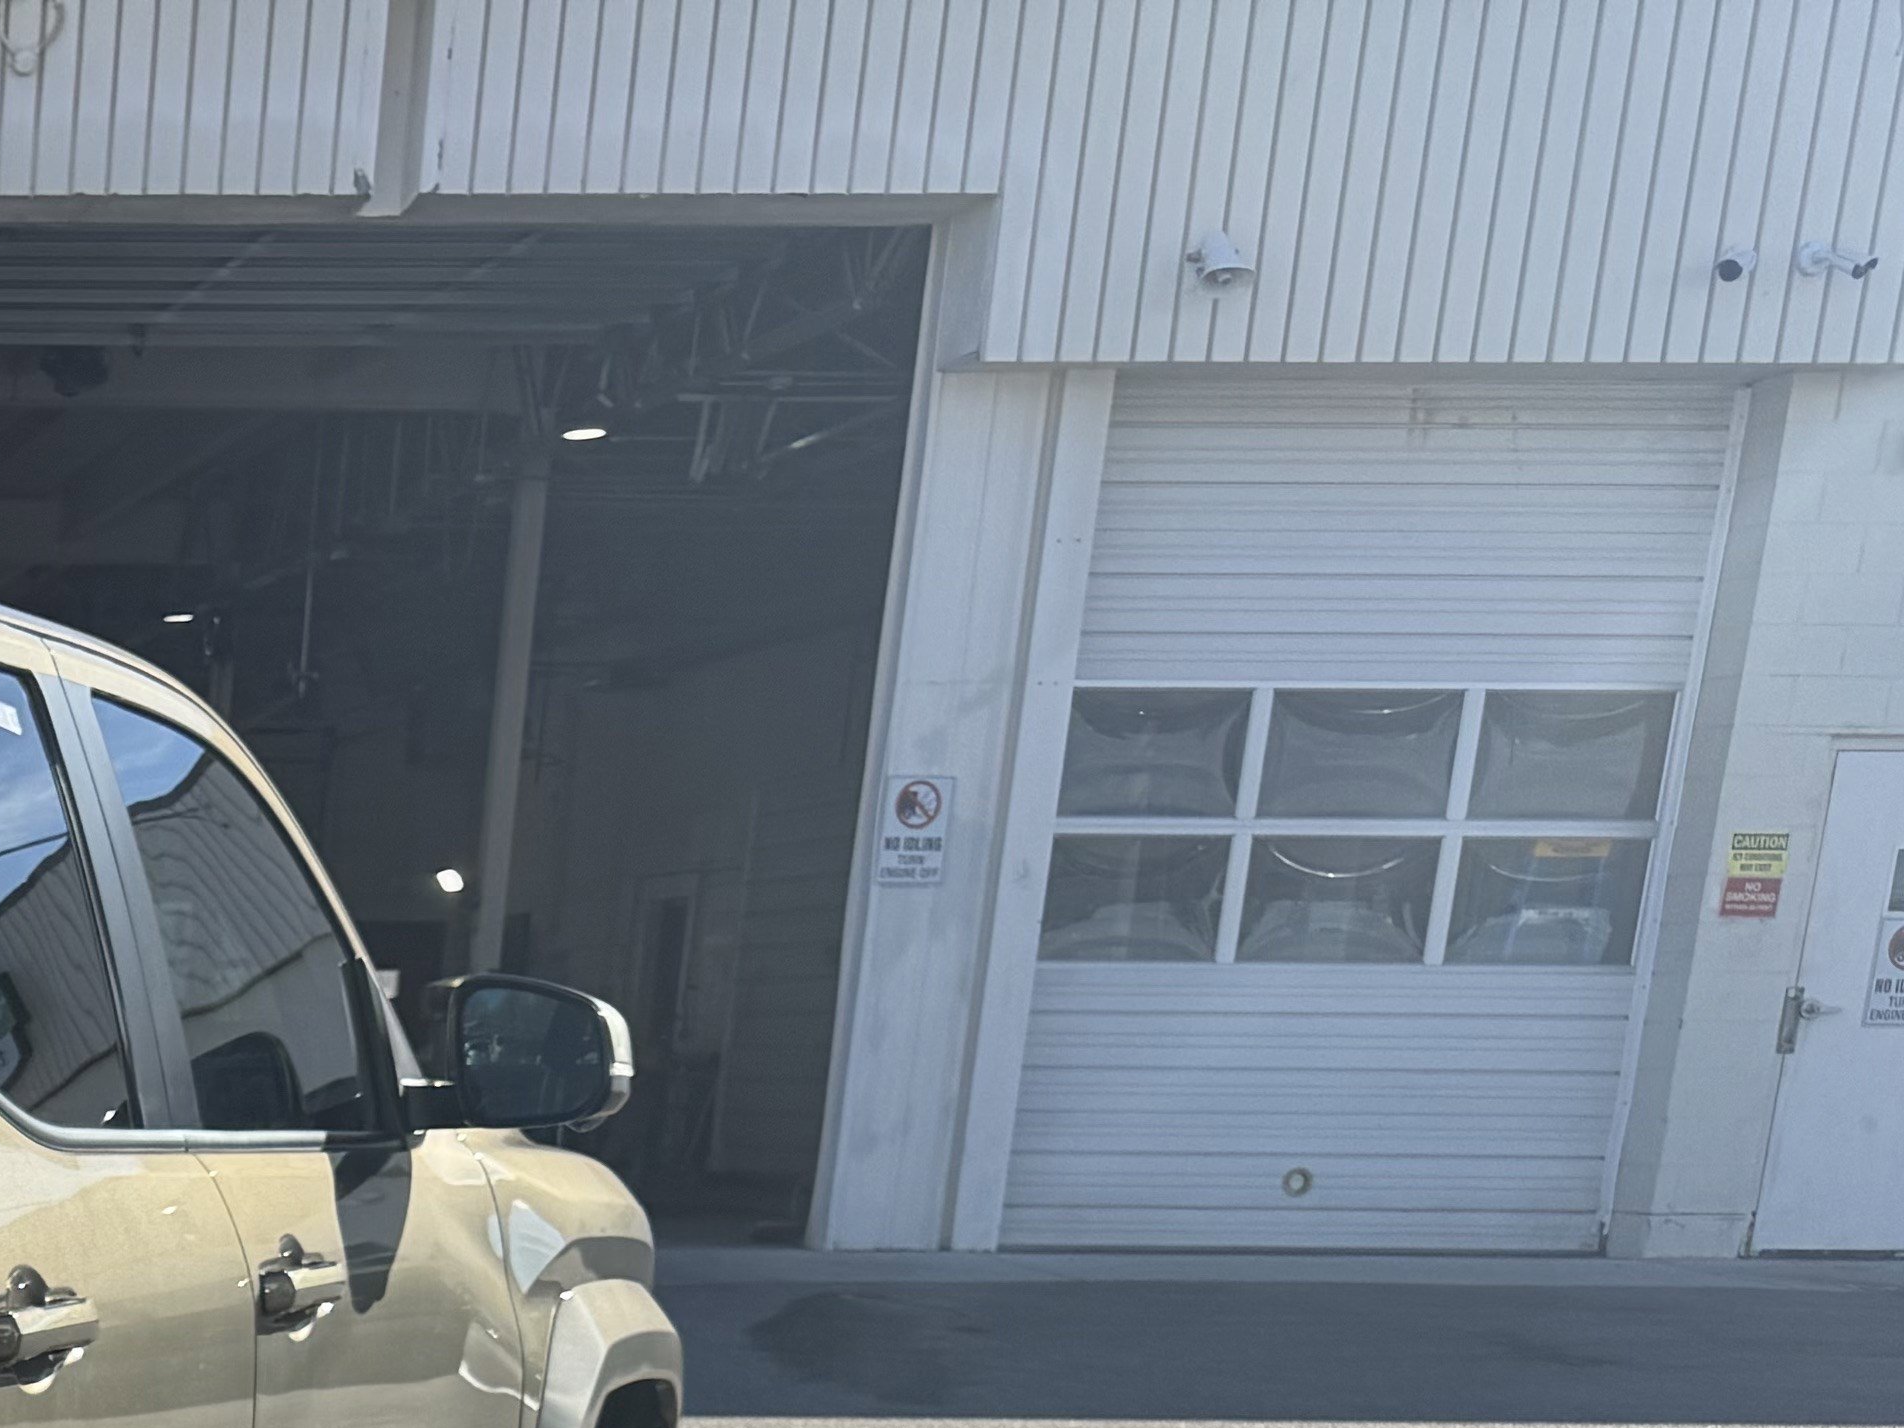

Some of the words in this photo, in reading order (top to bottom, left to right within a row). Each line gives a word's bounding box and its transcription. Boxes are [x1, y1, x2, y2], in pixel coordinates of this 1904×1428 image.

[1733, 835, 1787, 848] CAUTION
[1745, 882, 1762, 892] NO
[1725, 892, 1776, 902] SMOKING
[1874, 978, 1892, 994] NO
